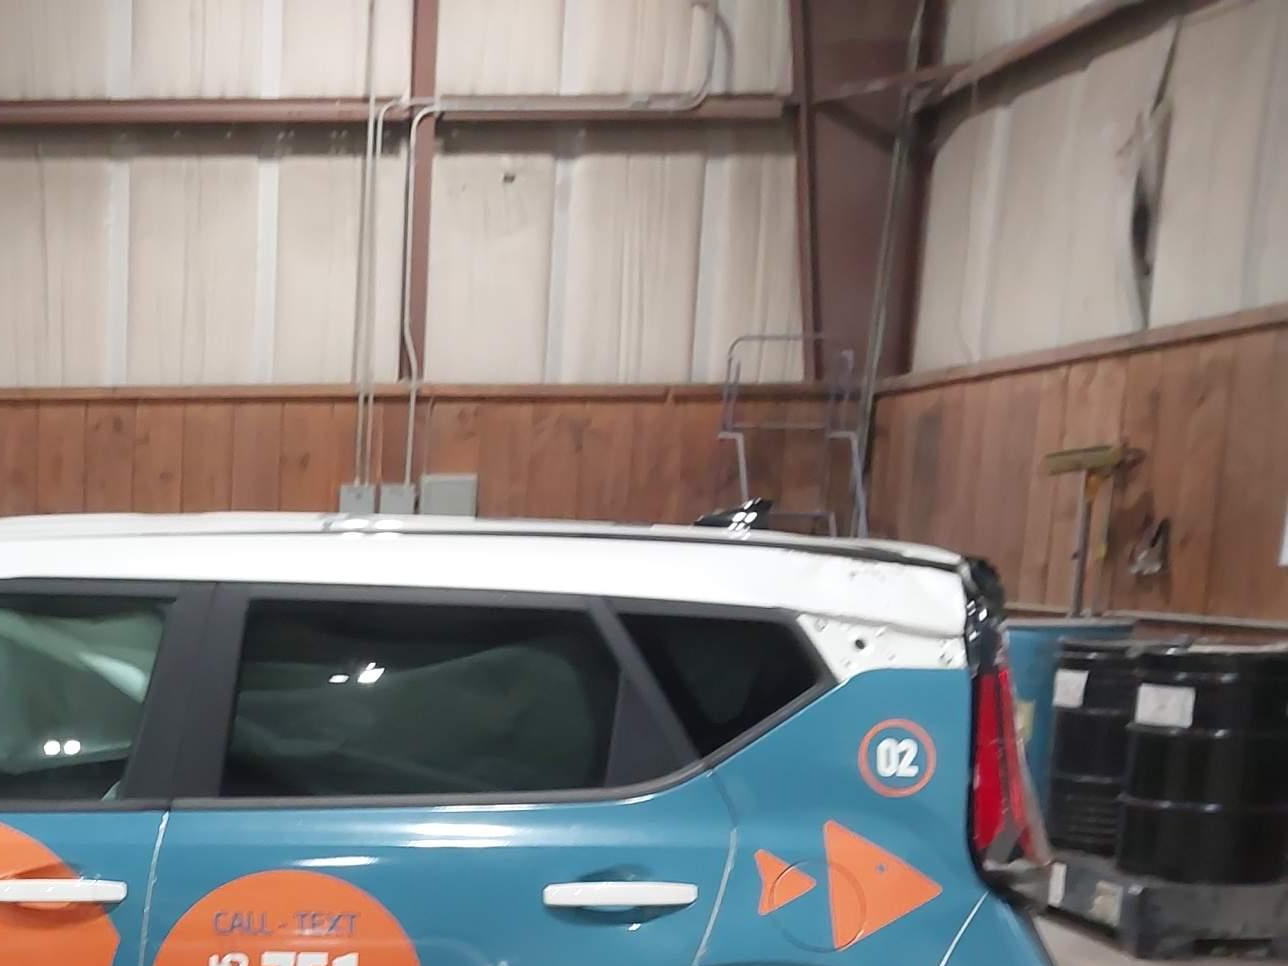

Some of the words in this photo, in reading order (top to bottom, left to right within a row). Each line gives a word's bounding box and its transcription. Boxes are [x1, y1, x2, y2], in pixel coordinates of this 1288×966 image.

[876, 737, 919, 777] 02
[214, 911, 274, 936] CALL
[296, 911, 360, 937] TEXT
